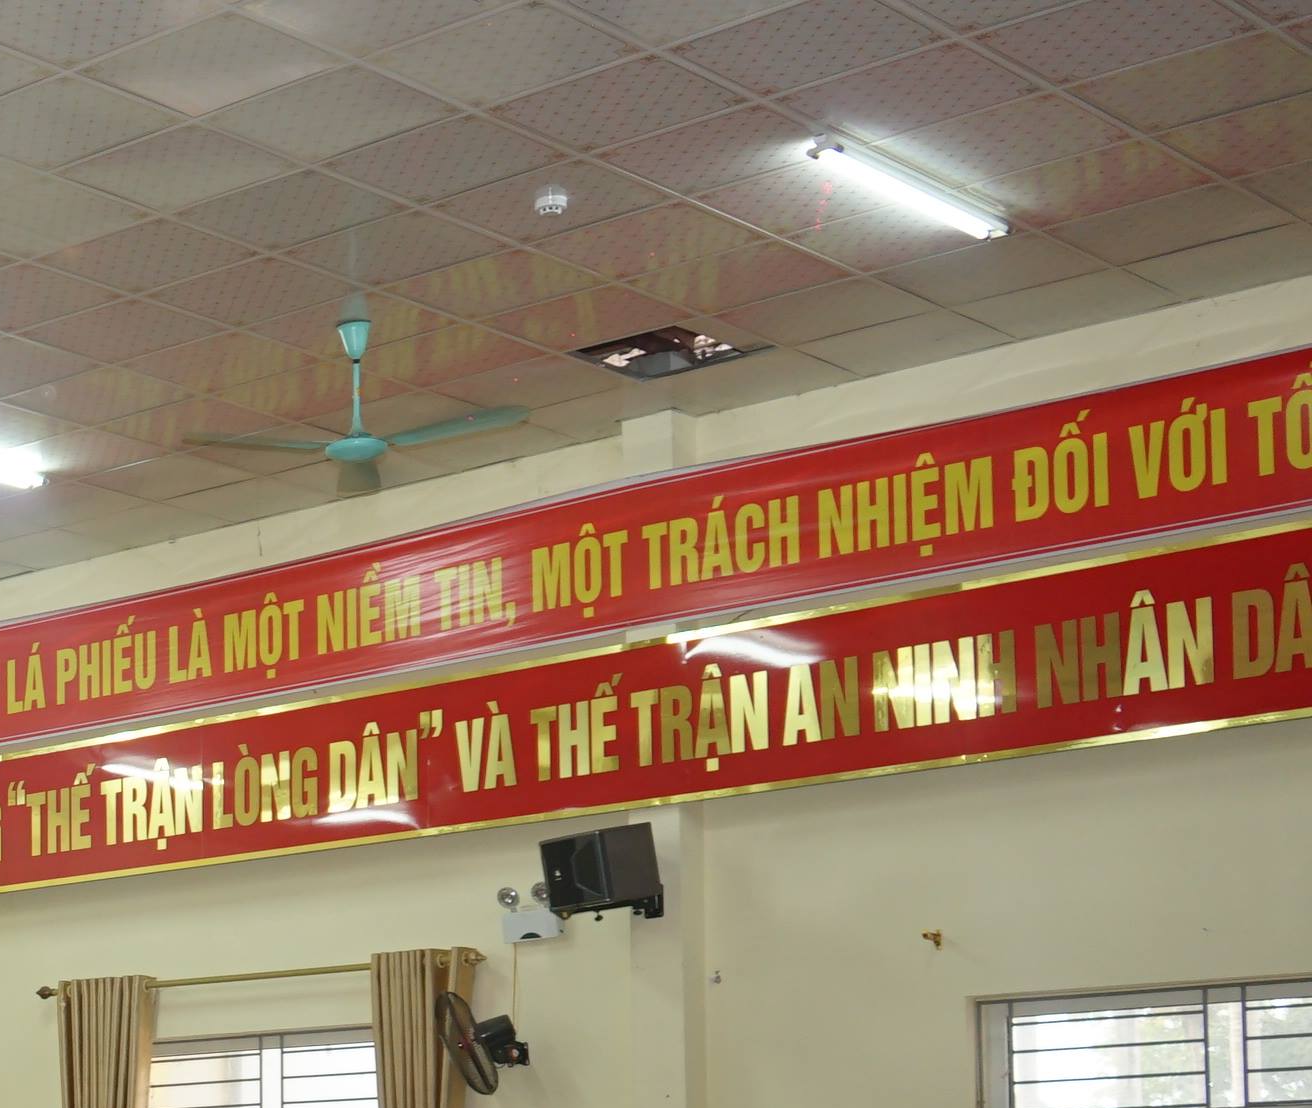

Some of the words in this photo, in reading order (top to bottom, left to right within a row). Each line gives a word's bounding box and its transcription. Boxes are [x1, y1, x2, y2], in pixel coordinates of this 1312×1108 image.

[7, 641, 46, 715] LÁ
[56, 615, 157, 705] PHIẾU
[169, 607, 213, 684] LÀ
[224, 592, 305, 679] MỘT
[316, 562, 422, 655] NIỀM
[434, 556, 516, 628] TIN,
[532, 523, 630, 618] MỘT
[641, 495, 801, 590] TRÁCH
[818, 452, 994, 558] NHIỆM
[1012, 410, 1110, 523] ĐỐI
[1128, 397, 1228, 500] VỚI
[100, 757, 204, 850] TRẬN
[212, 743, 319, 830] LÒNG
[455, 701, 518, 792] VÀ
[531, 674, 621, 782] THẾ
[630, 663, 769, 773] TRẬN
[782, 656, 861, 747] AN
[872, 628, 1017, 732] NINH
[1034, 588, 1214, 709] NHÂN
